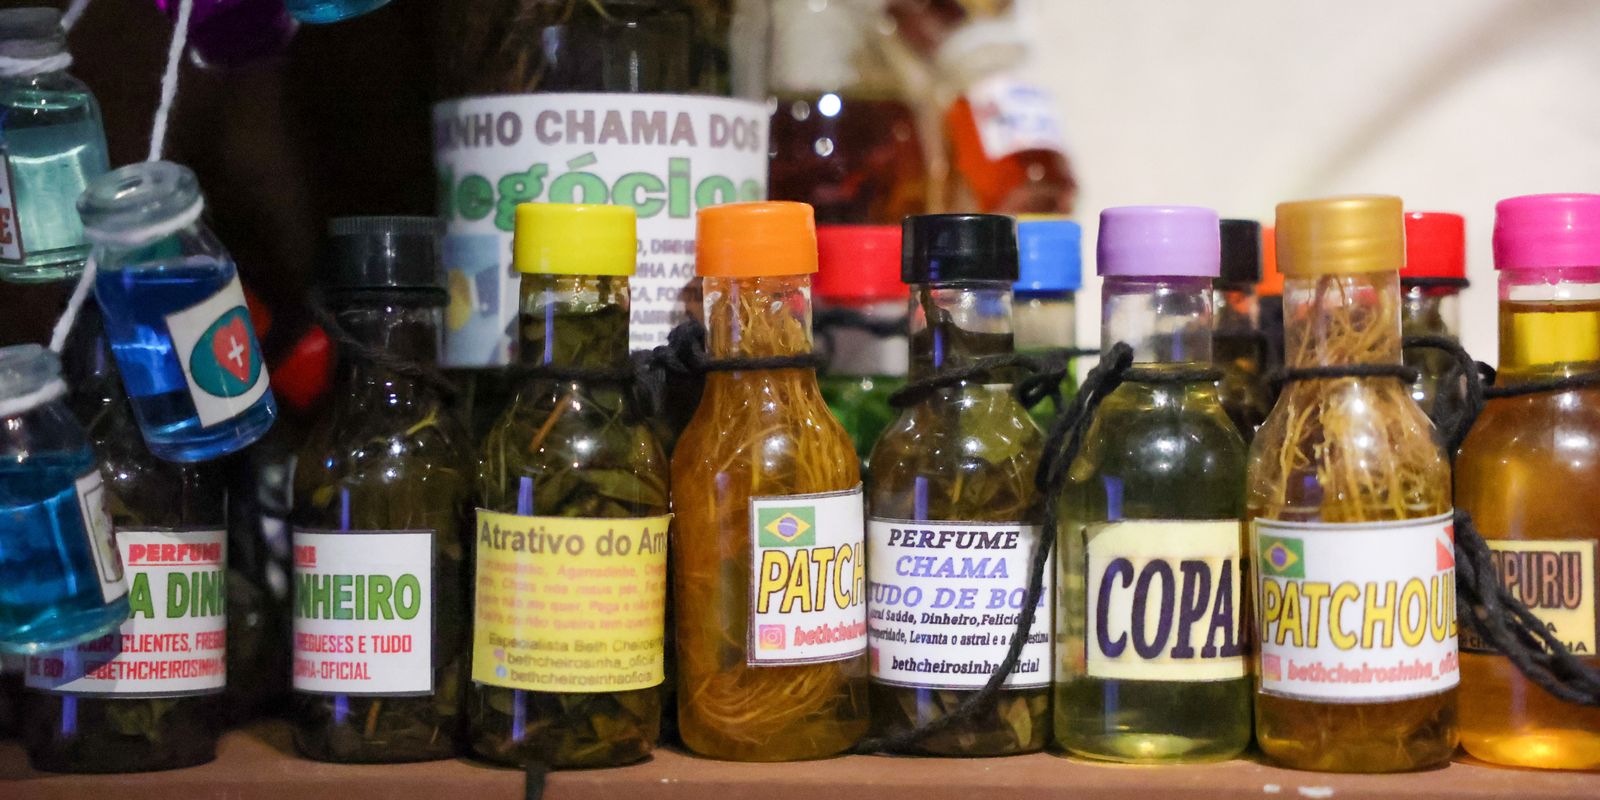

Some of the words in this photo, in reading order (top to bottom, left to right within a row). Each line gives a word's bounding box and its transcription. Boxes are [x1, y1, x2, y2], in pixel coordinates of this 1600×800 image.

[535, 110, 697, 146] CHAMA
[710, 113, 761, 150] DOS
[479, 519, 585, 556] Atrativo
[595, 528, 632, 557] do
[887, 527, 1020, 550] PERFUME
[895, 555, 1009, 579] CHAMA
[930, 587, 979, 609] DE
[358, 635, 367, 654] E
[371, 634, 412, 654] TUDO
[909, 631, 948, 645] Levanta
[951, 634, 958, 645] o
[960, 632, 990, 646] astral
[992, 634, 999, 644] e
[1000, 635, 1006, 645] a
